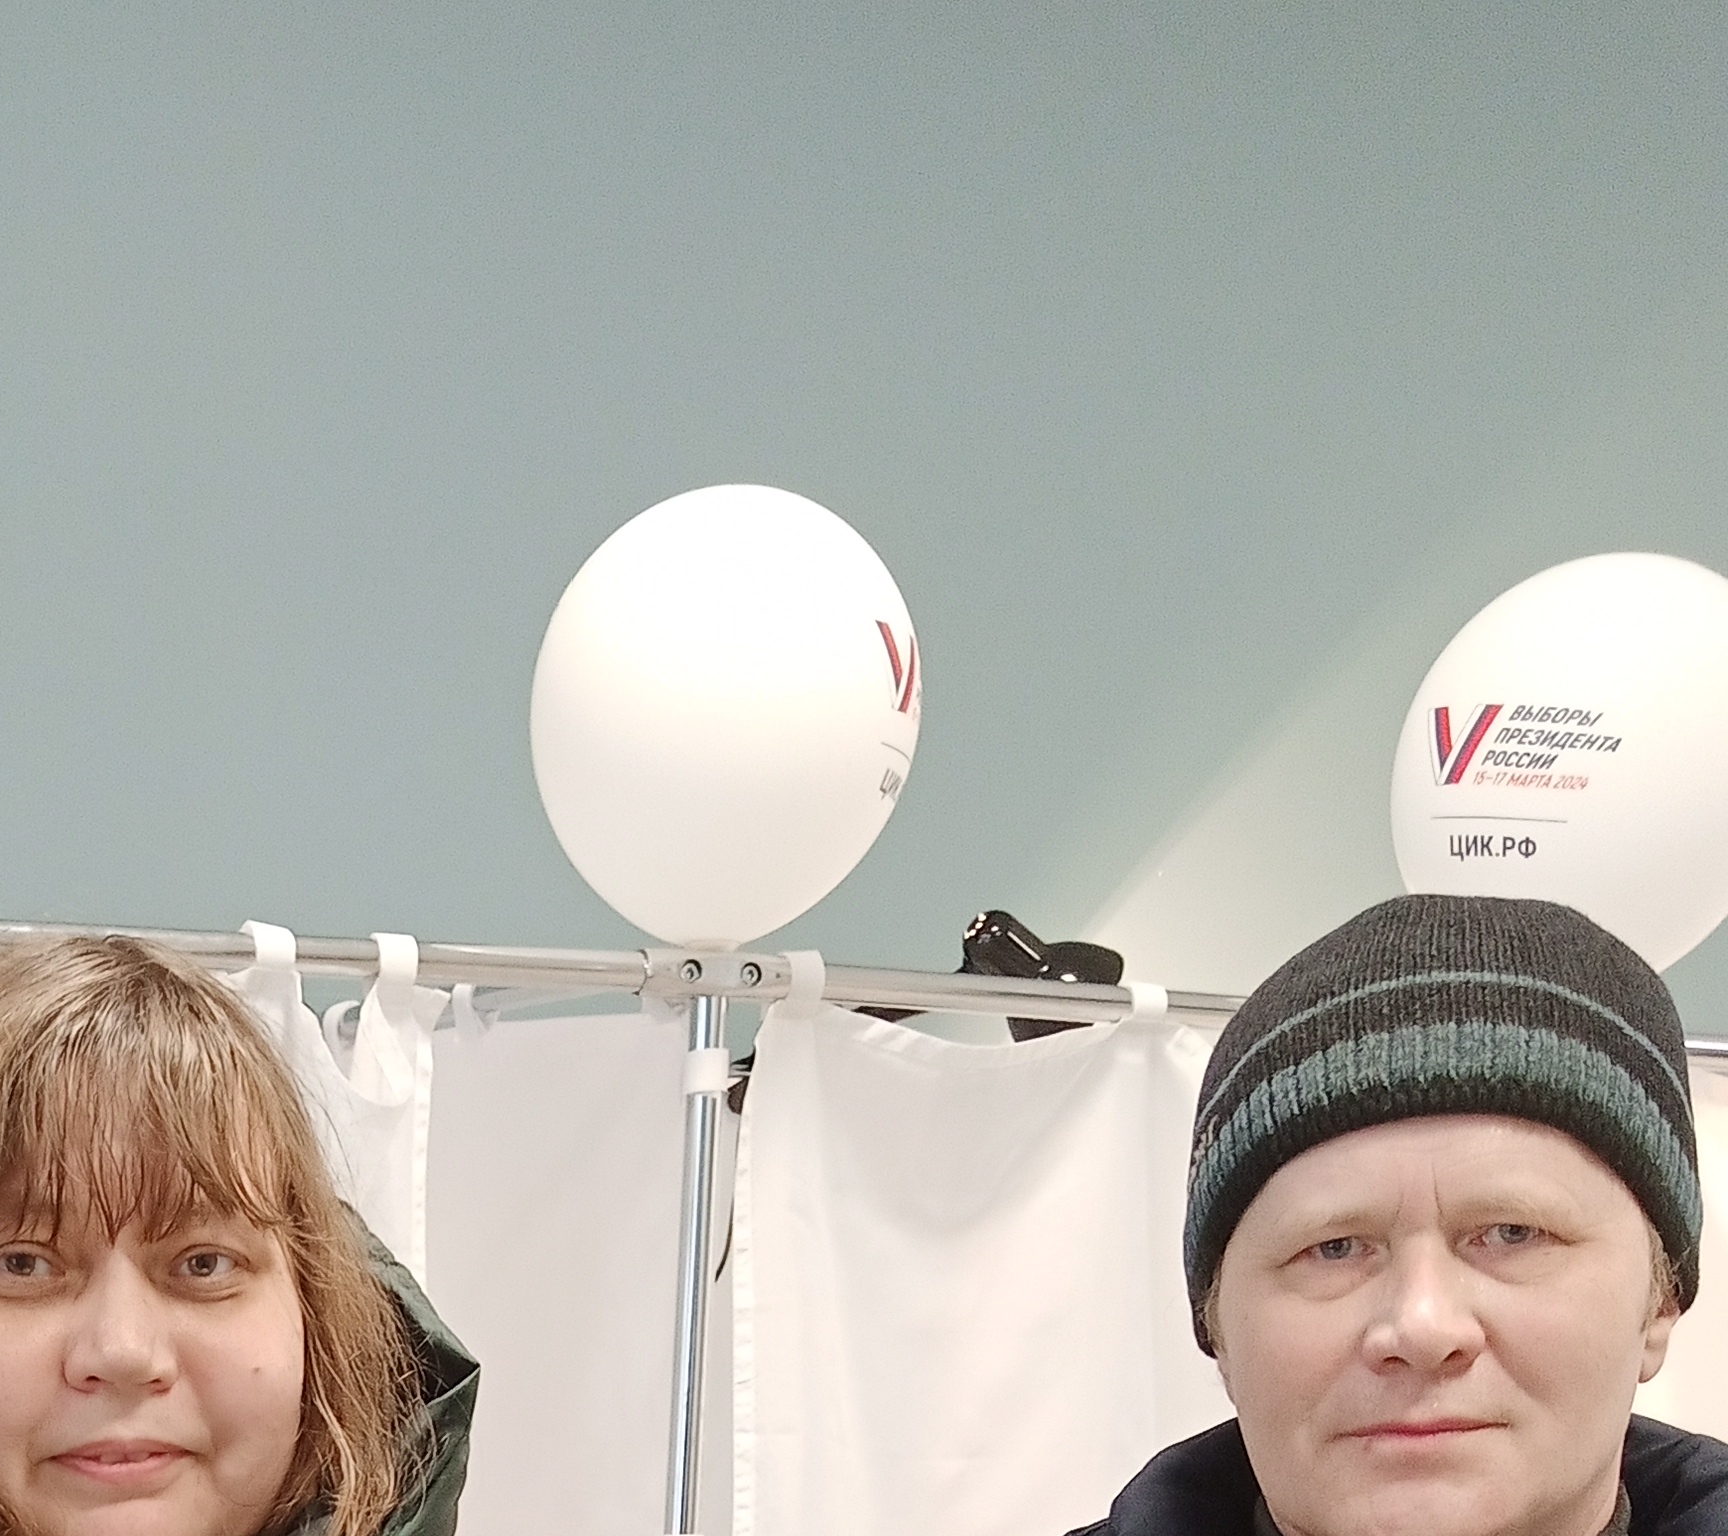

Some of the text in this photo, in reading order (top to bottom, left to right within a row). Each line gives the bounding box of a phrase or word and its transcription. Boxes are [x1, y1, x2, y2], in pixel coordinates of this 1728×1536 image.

[1509, 704, 1604, 728] ВЫБОРЫ
[1493, 727, 1622, 753] ПРЕЗИДЕНТА
[1481, 749, 1559, 770] РОССИИ
[1506, 772, 1553, 789] МАРТА
[1553, 774, 1589, 790] 2024
[1449, 834, 1537, 862] ЦИК.РФ
